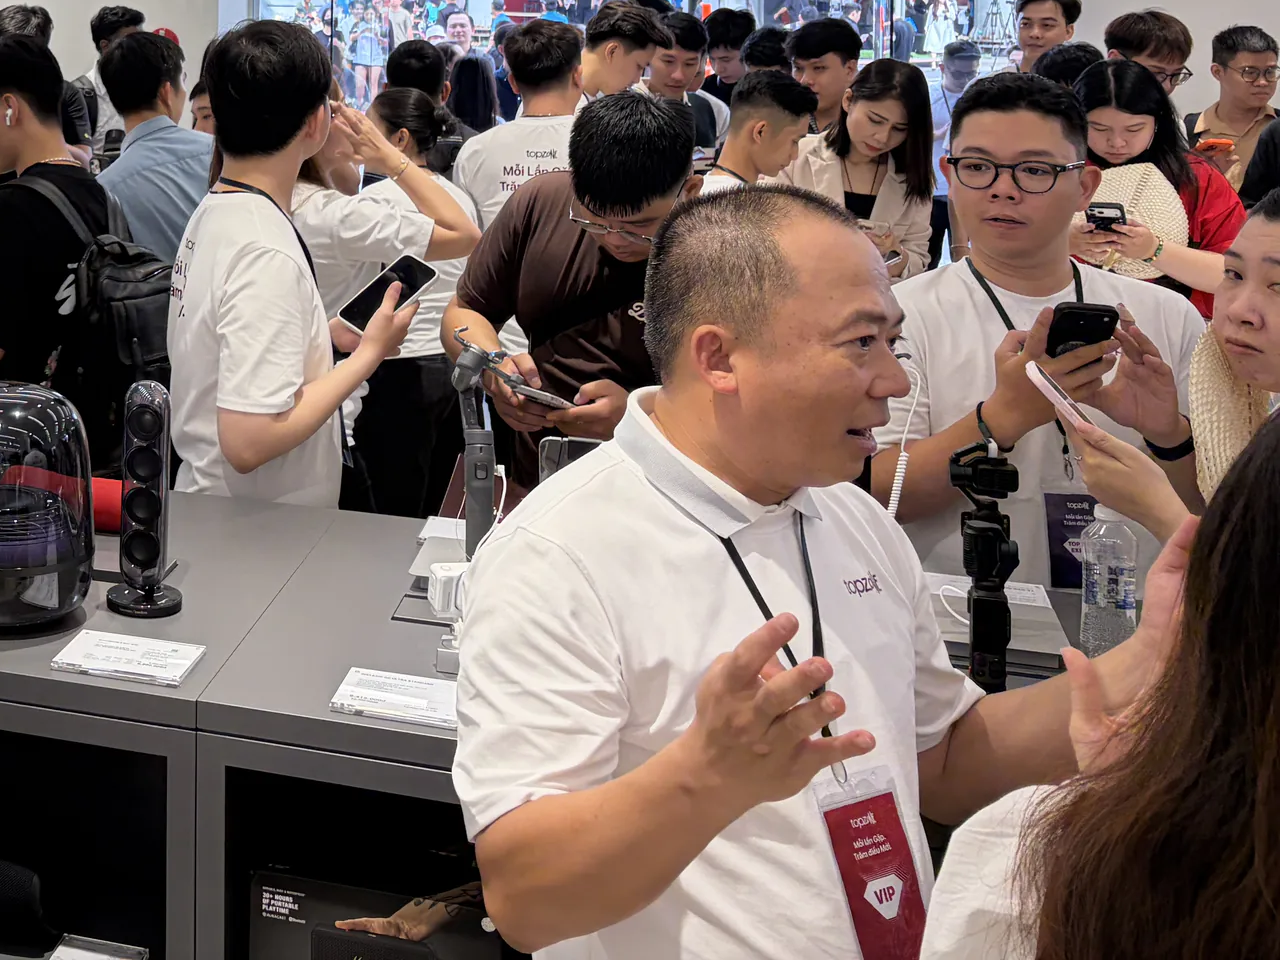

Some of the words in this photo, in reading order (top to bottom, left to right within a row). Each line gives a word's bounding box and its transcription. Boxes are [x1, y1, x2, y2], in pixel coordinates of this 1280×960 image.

[274, 894, 293, 903] HOURS
[873, 885, 895, 904] VIP
[262, 904, 289, 914] PLAYTIME
[270, 899, 298, 910] PORTABLE
